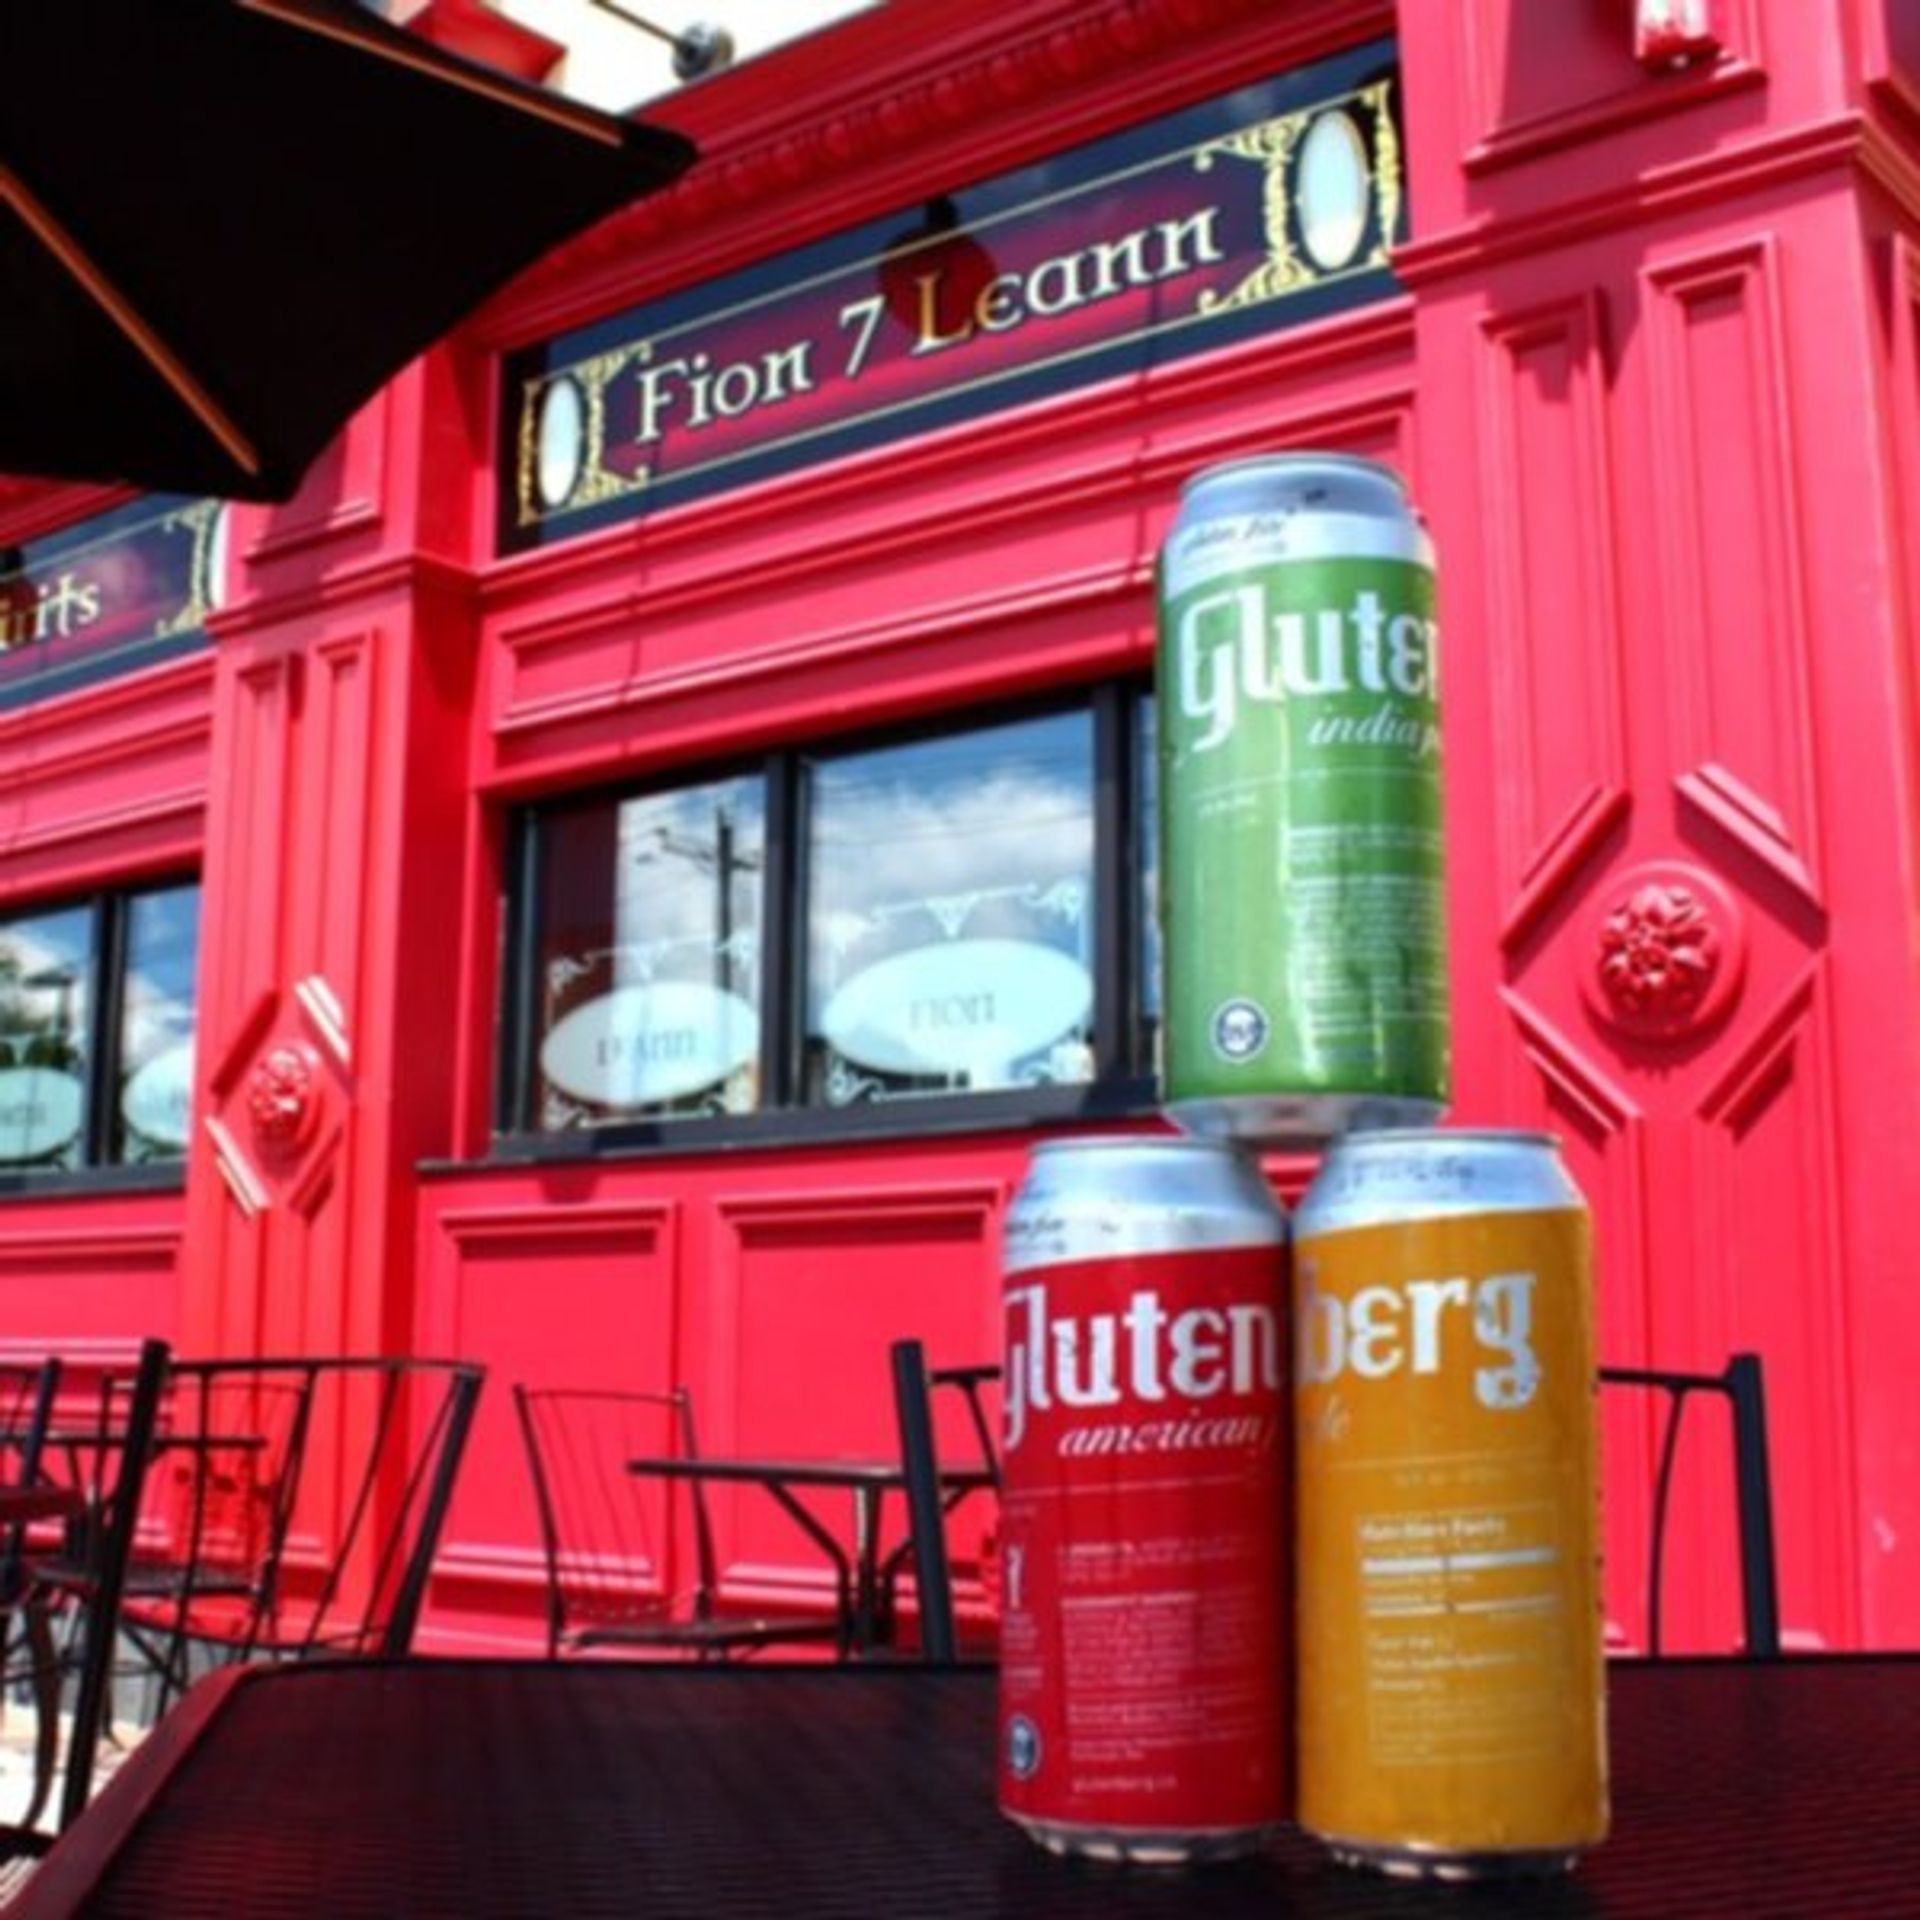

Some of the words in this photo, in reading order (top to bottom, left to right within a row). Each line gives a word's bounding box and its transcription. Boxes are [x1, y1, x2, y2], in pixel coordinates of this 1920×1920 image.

[634, 340, 812, 443] Fion
[911, 207, 1224, 355] Leann
[1058, 1405, 1263, 1456] american
